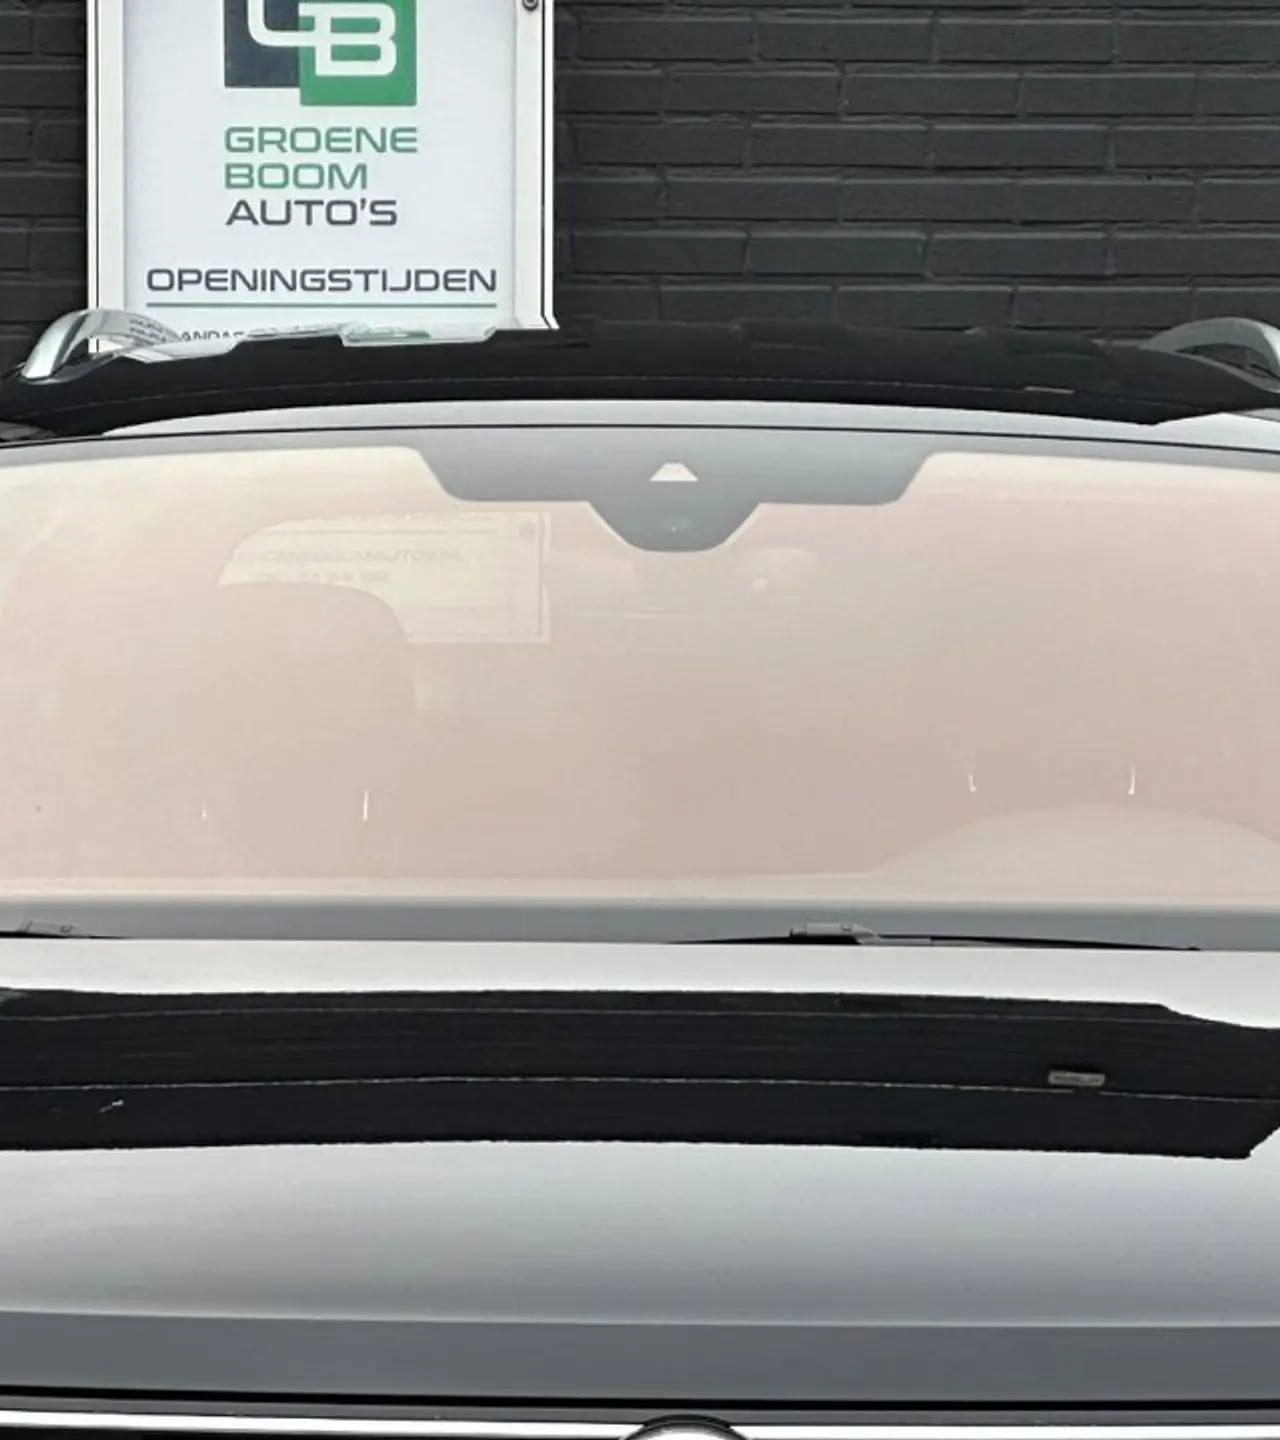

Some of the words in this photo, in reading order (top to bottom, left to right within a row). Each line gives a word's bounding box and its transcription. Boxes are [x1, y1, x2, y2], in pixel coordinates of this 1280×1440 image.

[224, 126, 418, 154] GROENE
[224, 162, 368, 190] BOOM
[225, 198, 398, 227] AUTO'S
[146, 268, 497, 293] OPENINGSTIJDEN
